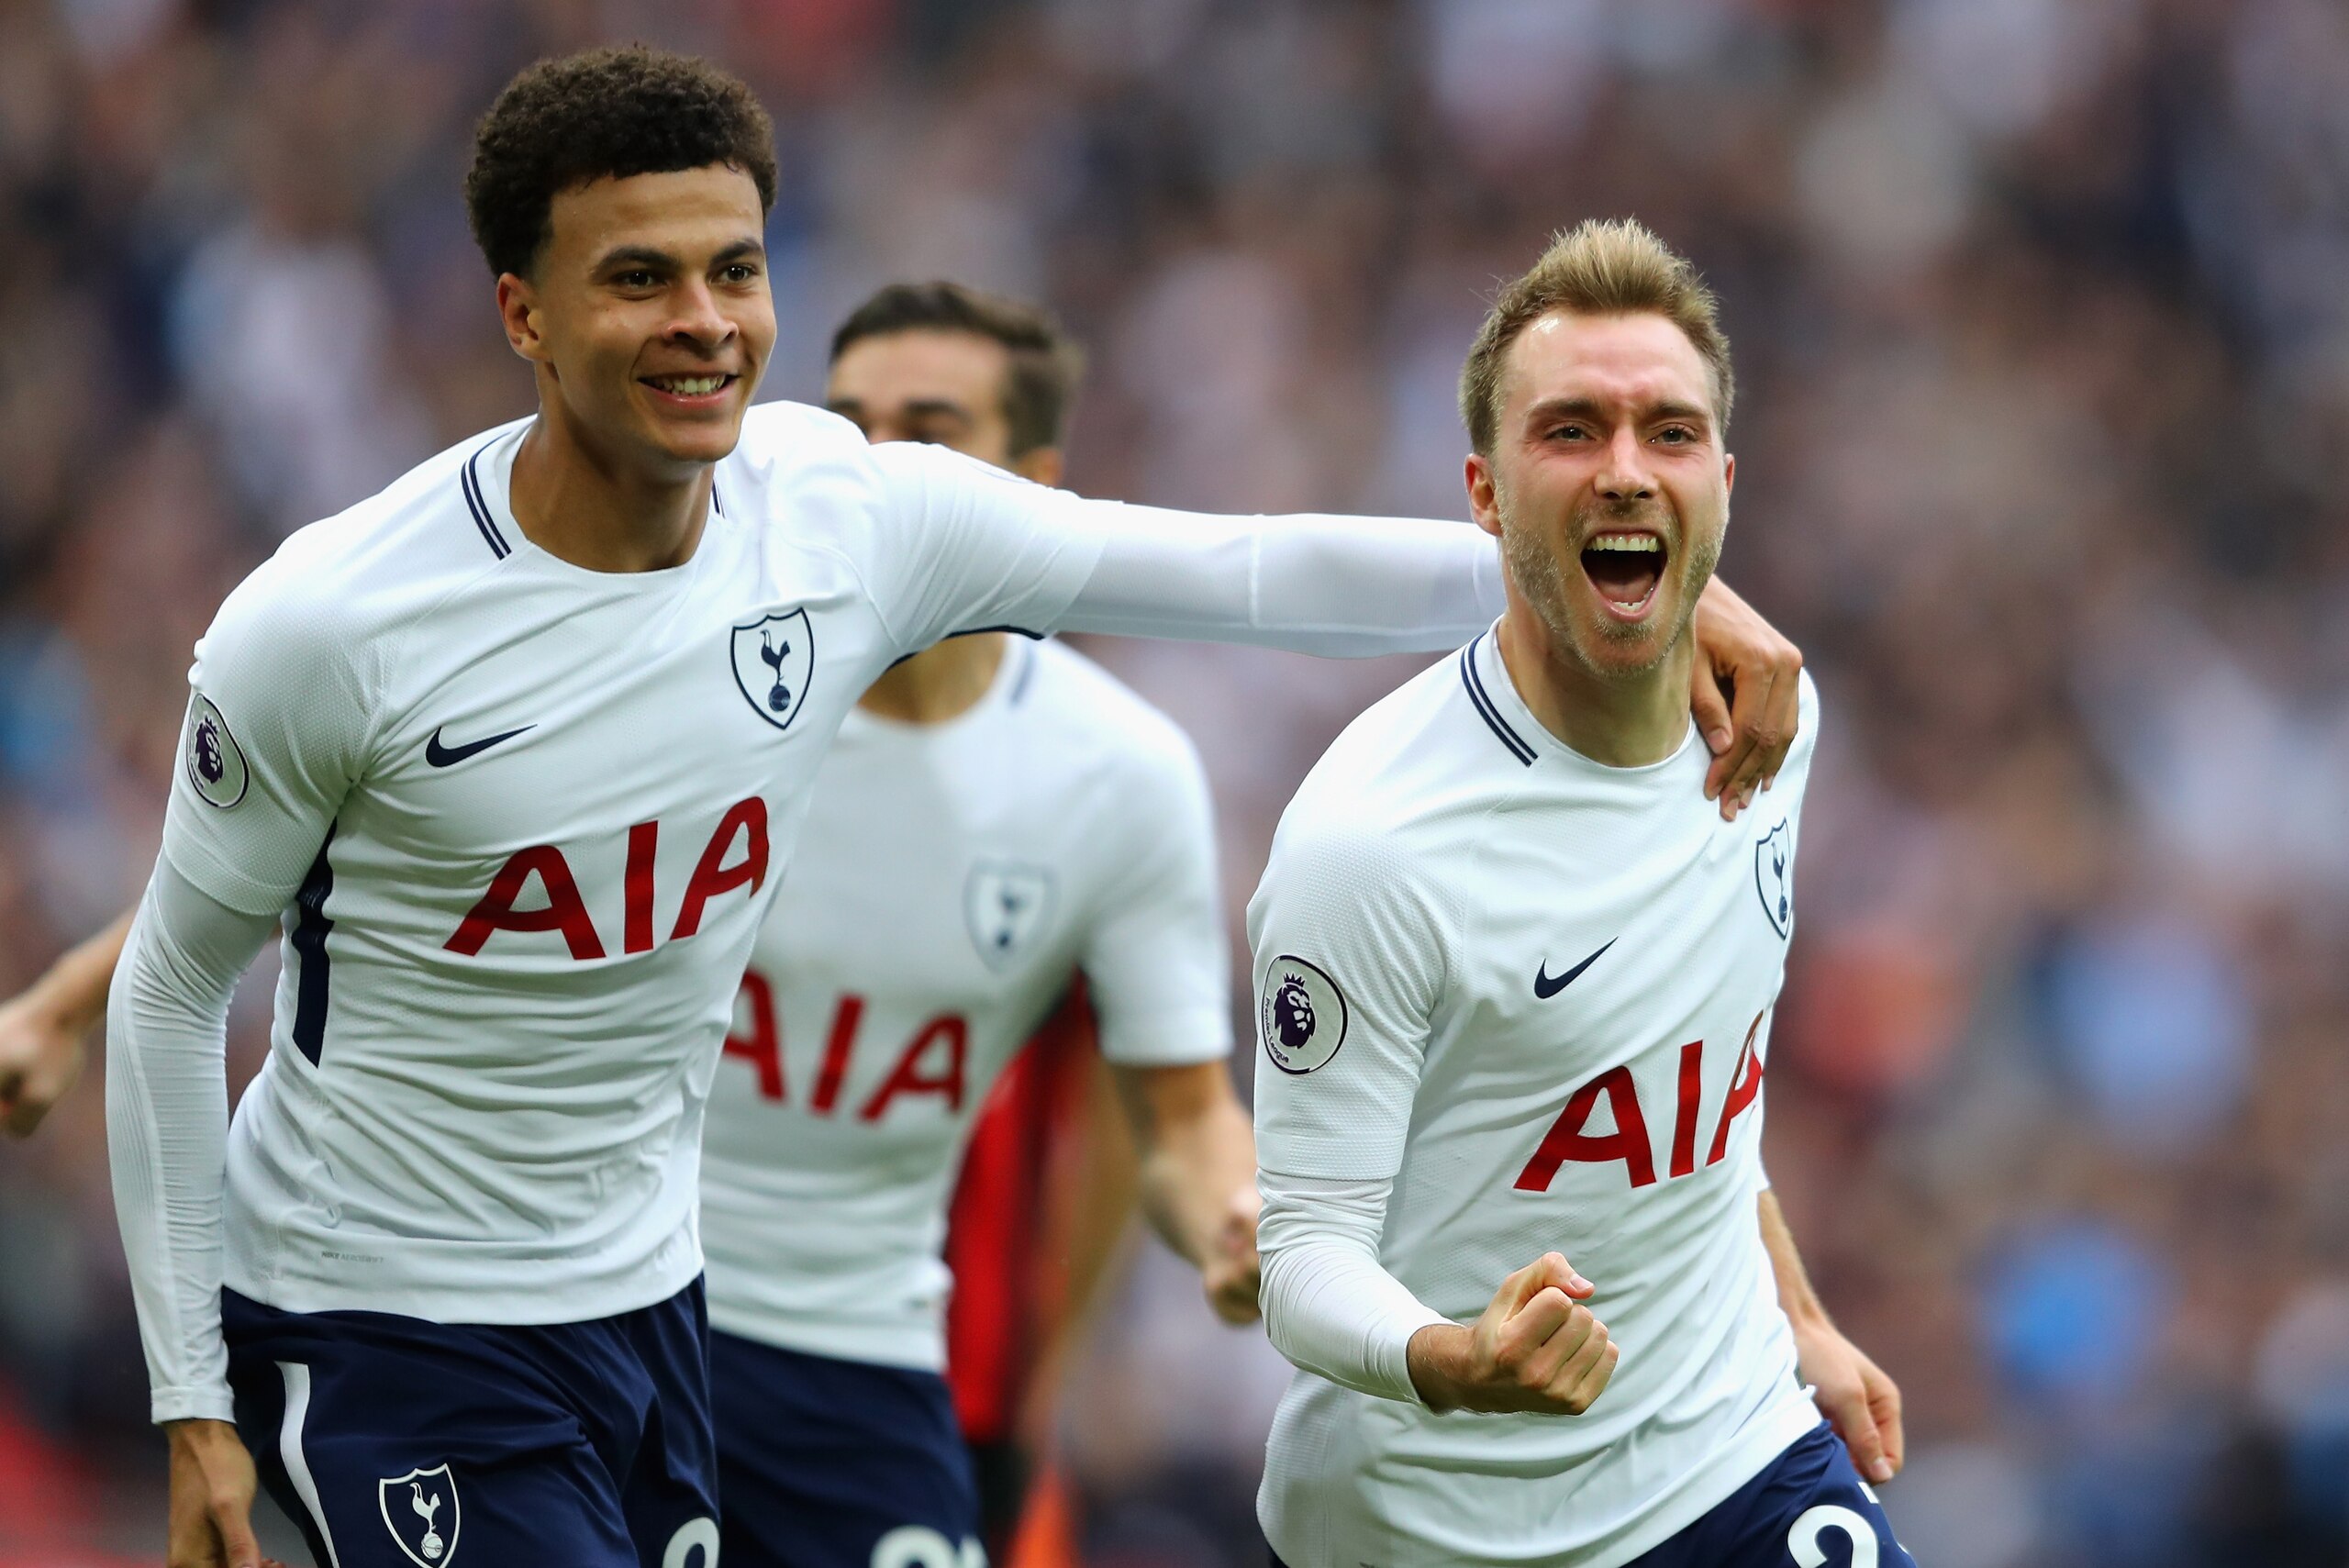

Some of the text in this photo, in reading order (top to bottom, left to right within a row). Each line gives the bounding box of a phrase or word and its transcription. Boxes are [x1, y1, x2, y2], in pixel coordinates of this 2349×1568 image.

[443, 795, 769, 960] AIA
[721, 968, 969, 1123] AIA
[1513, 1008, 1764, 1192] AIA
